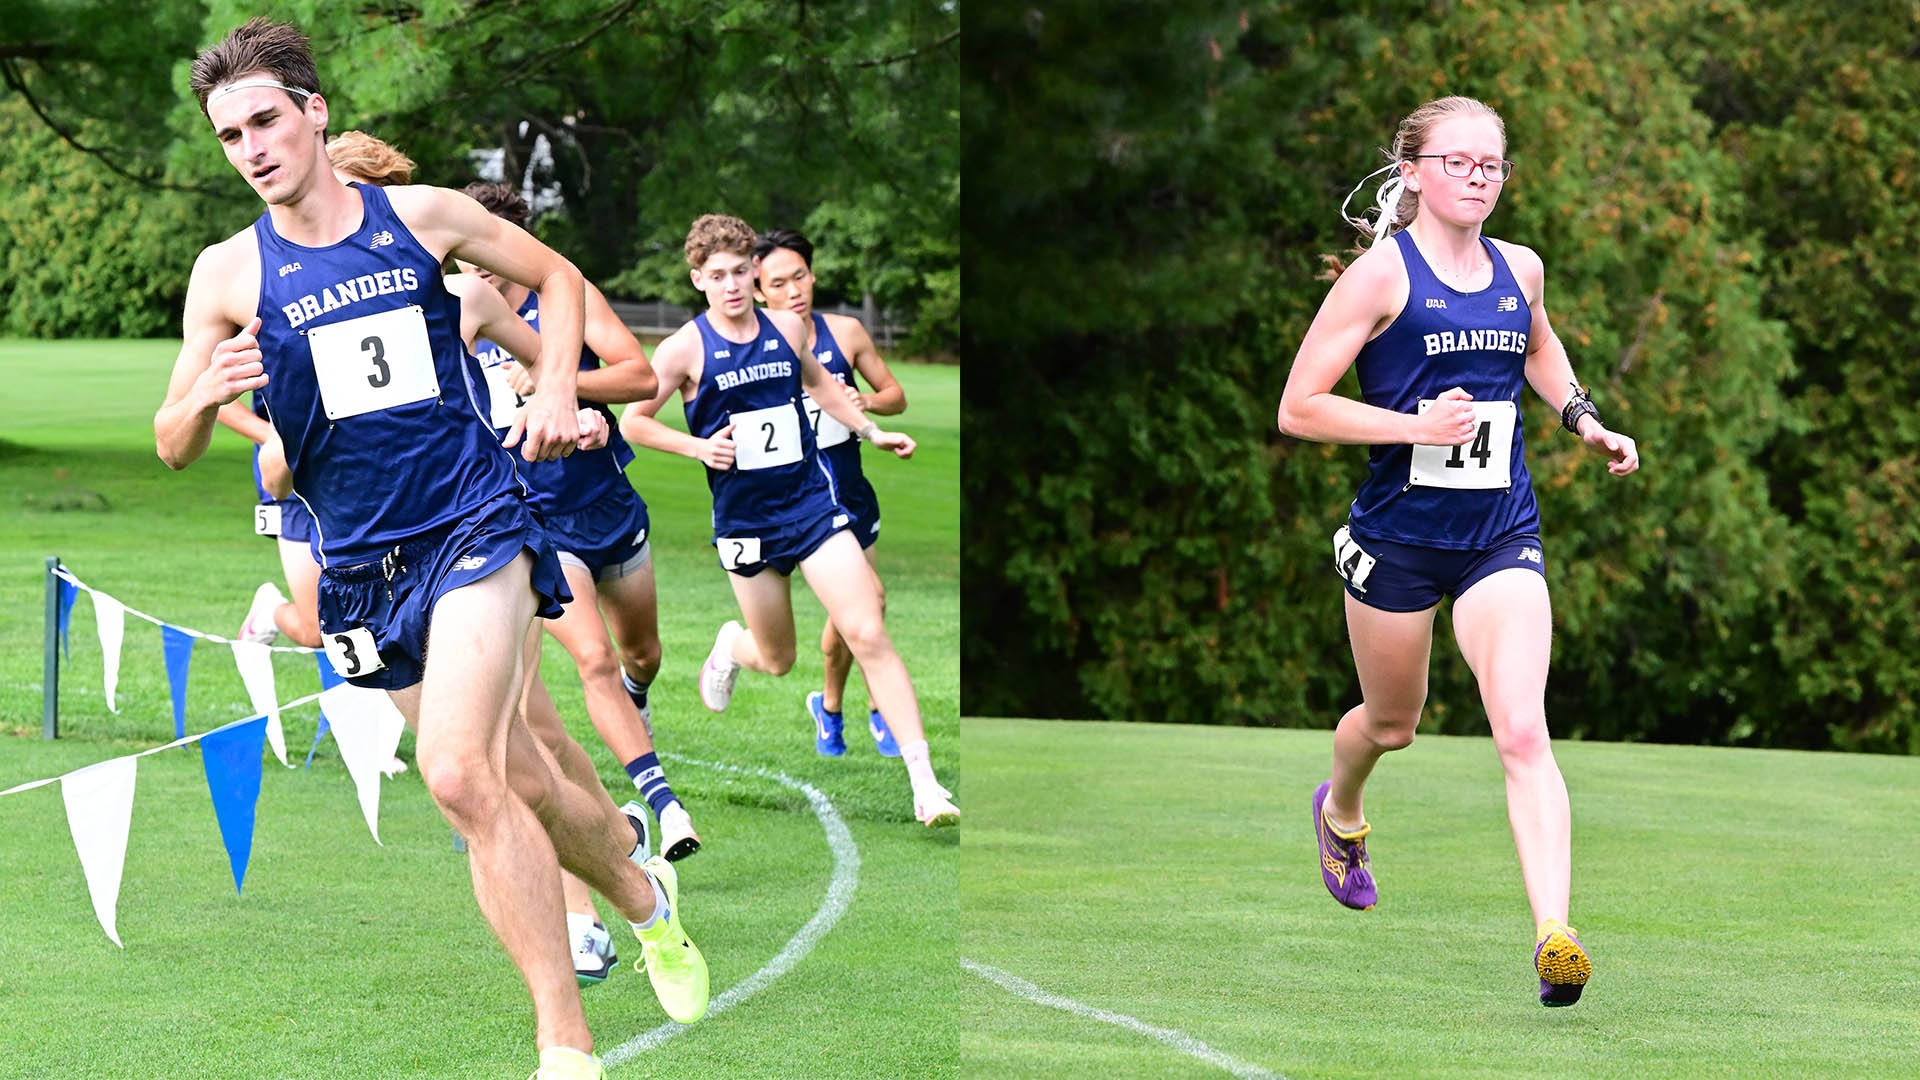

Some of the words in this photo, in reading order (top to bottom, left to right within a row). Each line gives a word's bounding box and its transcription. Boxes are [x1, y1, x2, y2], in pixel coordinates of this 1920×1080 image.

[281, 267, 419, 329] BRANDEIS
[1425, 298, 1447, 309] UAA
[1423, 329, 1527, 356] BRANDEIS
[360, 335, 391, 388] 3
[714, 361, 792, 391] BRANDEIS
[809, 408, 821, 436] 7
[761, 422, 778, 453] 2
[258, 509, 268, 532] 5
[732, 541, 746, 567] 2
[334, 634, 361, 675] 3
